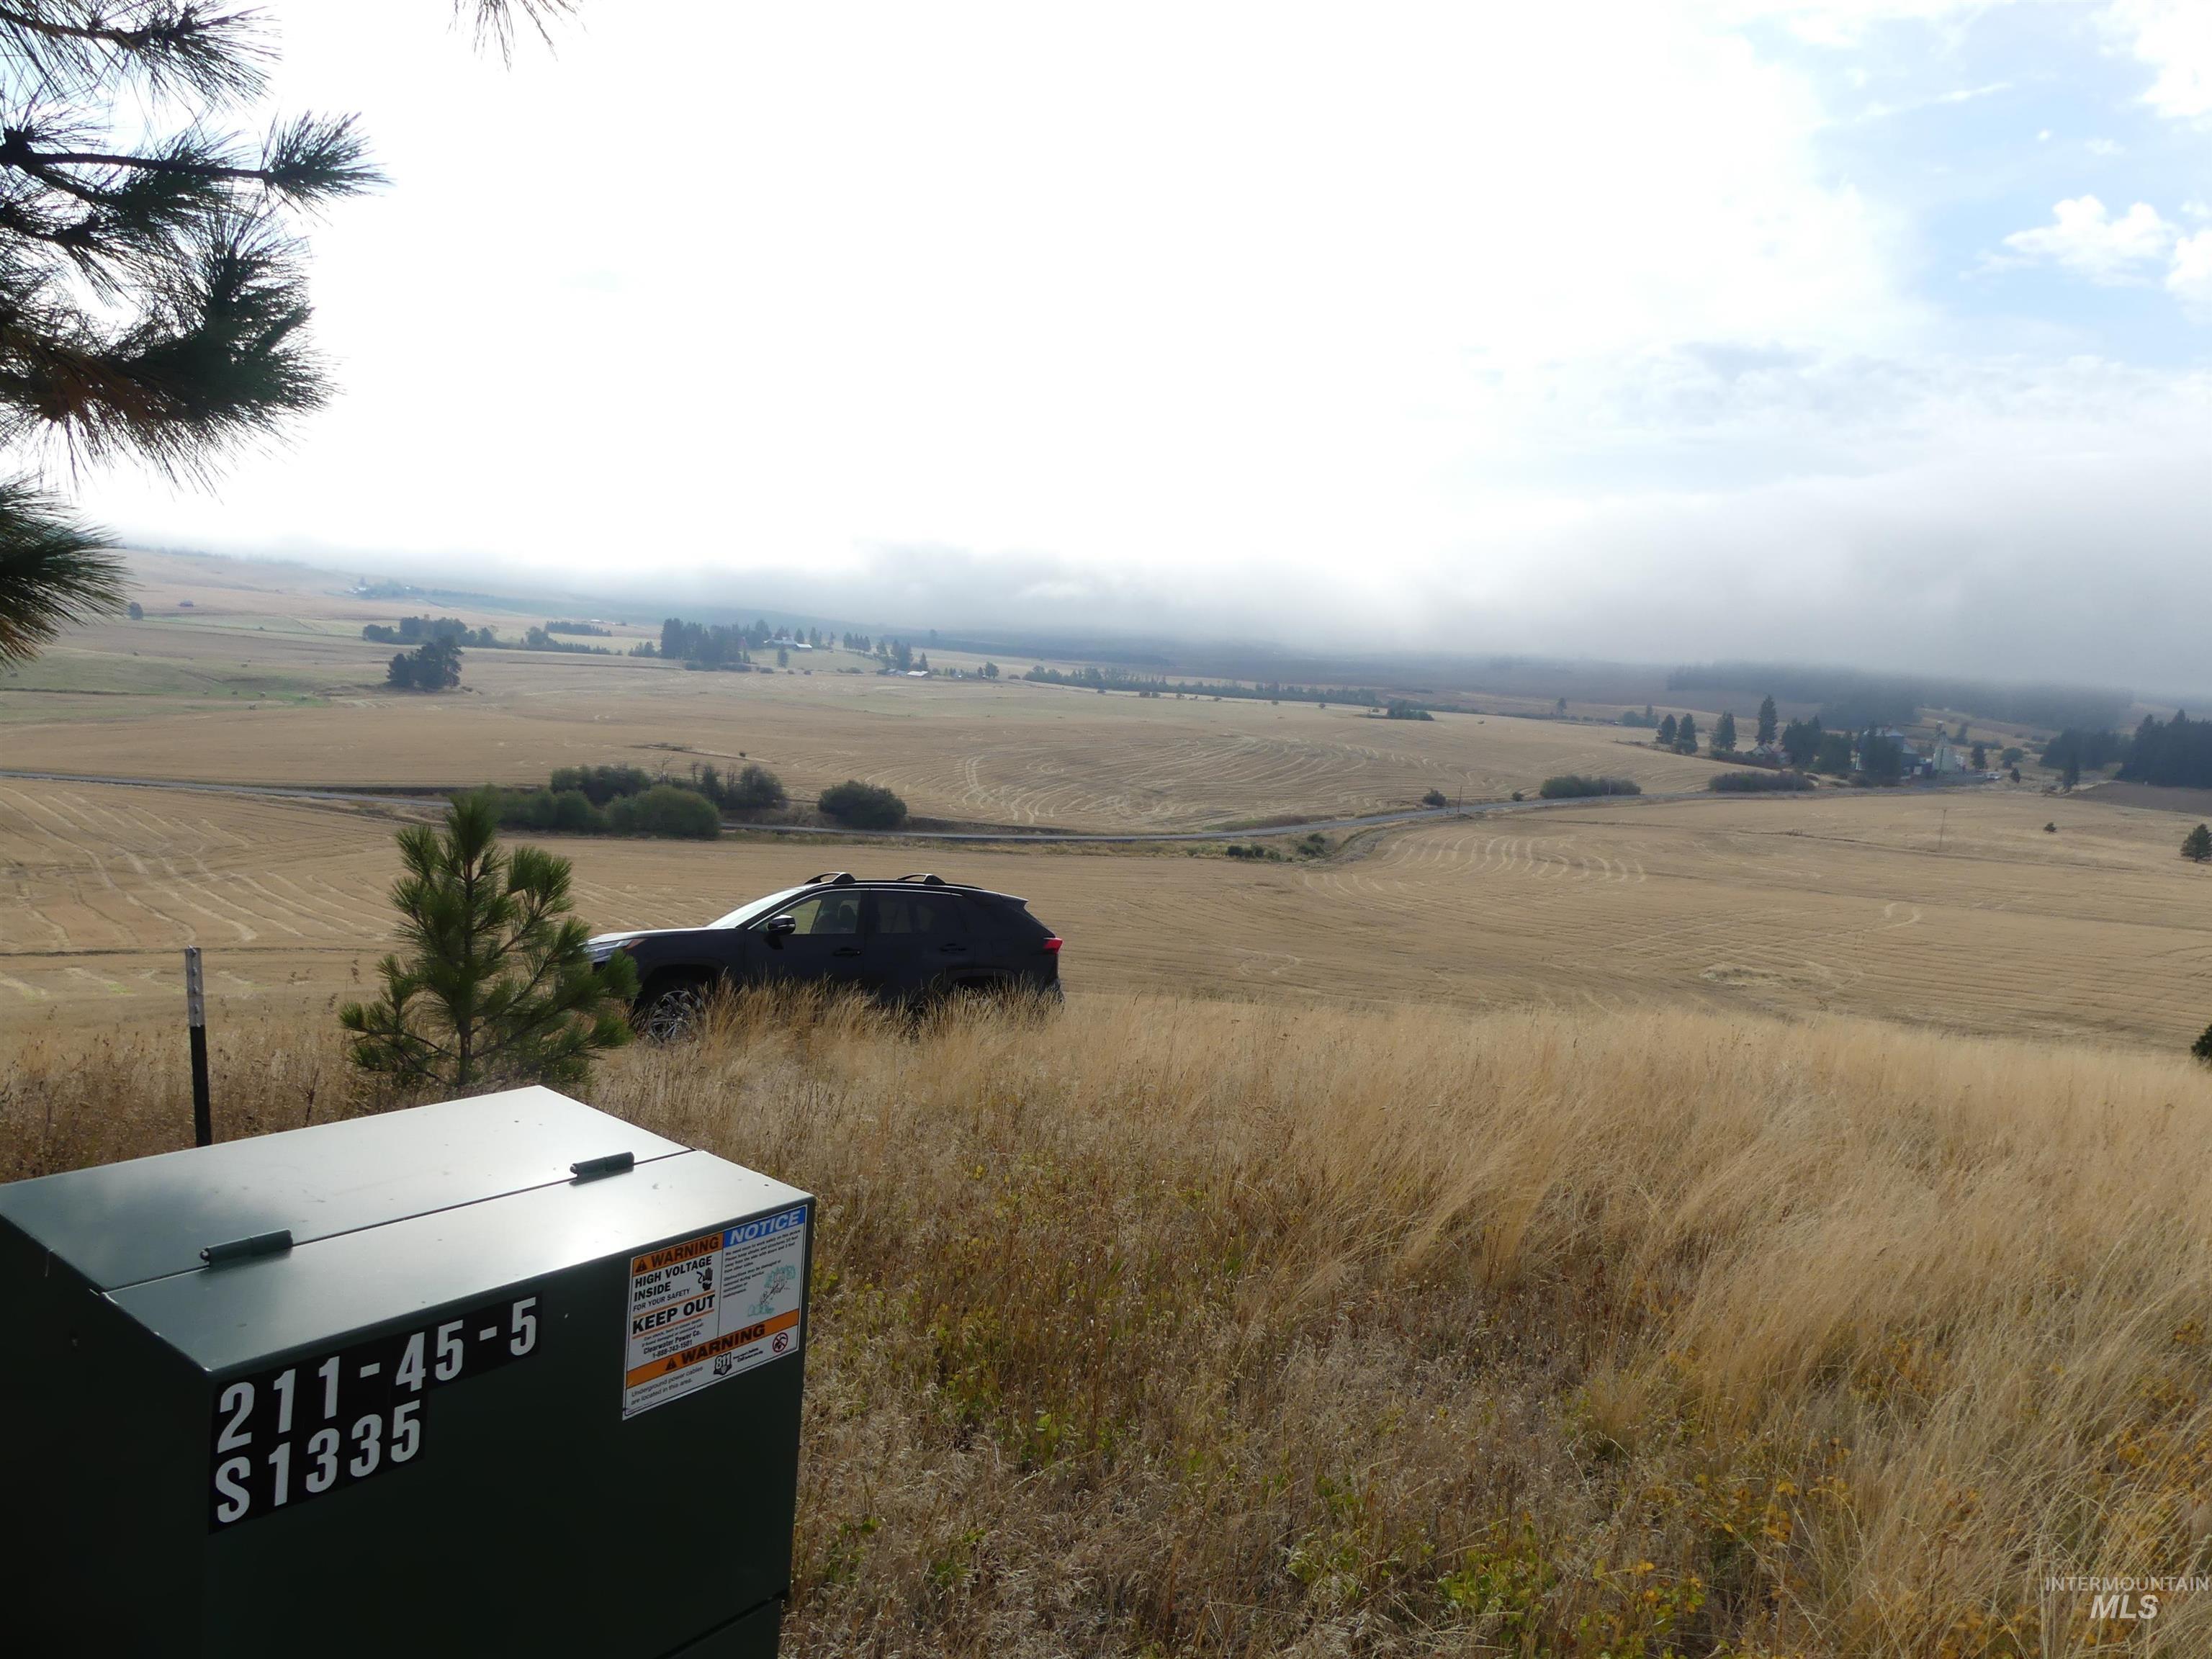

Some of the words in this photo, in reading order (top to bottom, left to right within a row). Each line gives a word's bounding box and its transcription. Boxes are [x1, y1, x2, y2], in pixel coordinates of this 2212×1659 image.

[729, 1210, 800, 1245] NOTICE
[650, 1236, 719, 1268] WARNING
[635, 1271, 661, 1288] HIGH
[665, 1256, 712, 1278] VOLTAGE
[633, 1302, 646, 1311] FOR
[648, 1297, 665, 1307] YOUR
[667, 1287, 691, 1301] SAFETY
[634, 1282, 671, 1302] INSIDE
[634, 1308, 678, 1334] KEEP
[683, 1294, 715, 1316] OUT
[644, 1338, 673, 1354] Clearwater
[675, 1332, 691, 1343] Power
[681, 1323, 765, 1364] WARNING
[217, 1296, 536, 1454] 211-45-5
[715, 1352, 732, 1370] 811
[631, 1378, 667, 1398] Underground
[668, 1372, 684, 1383] power
[685, 1364, 703, 1376] cables
[641, 1388, 661, 1401] located
[668, 1382, 678, 1390] this
[215, 1399, 421, 1523] S1335
